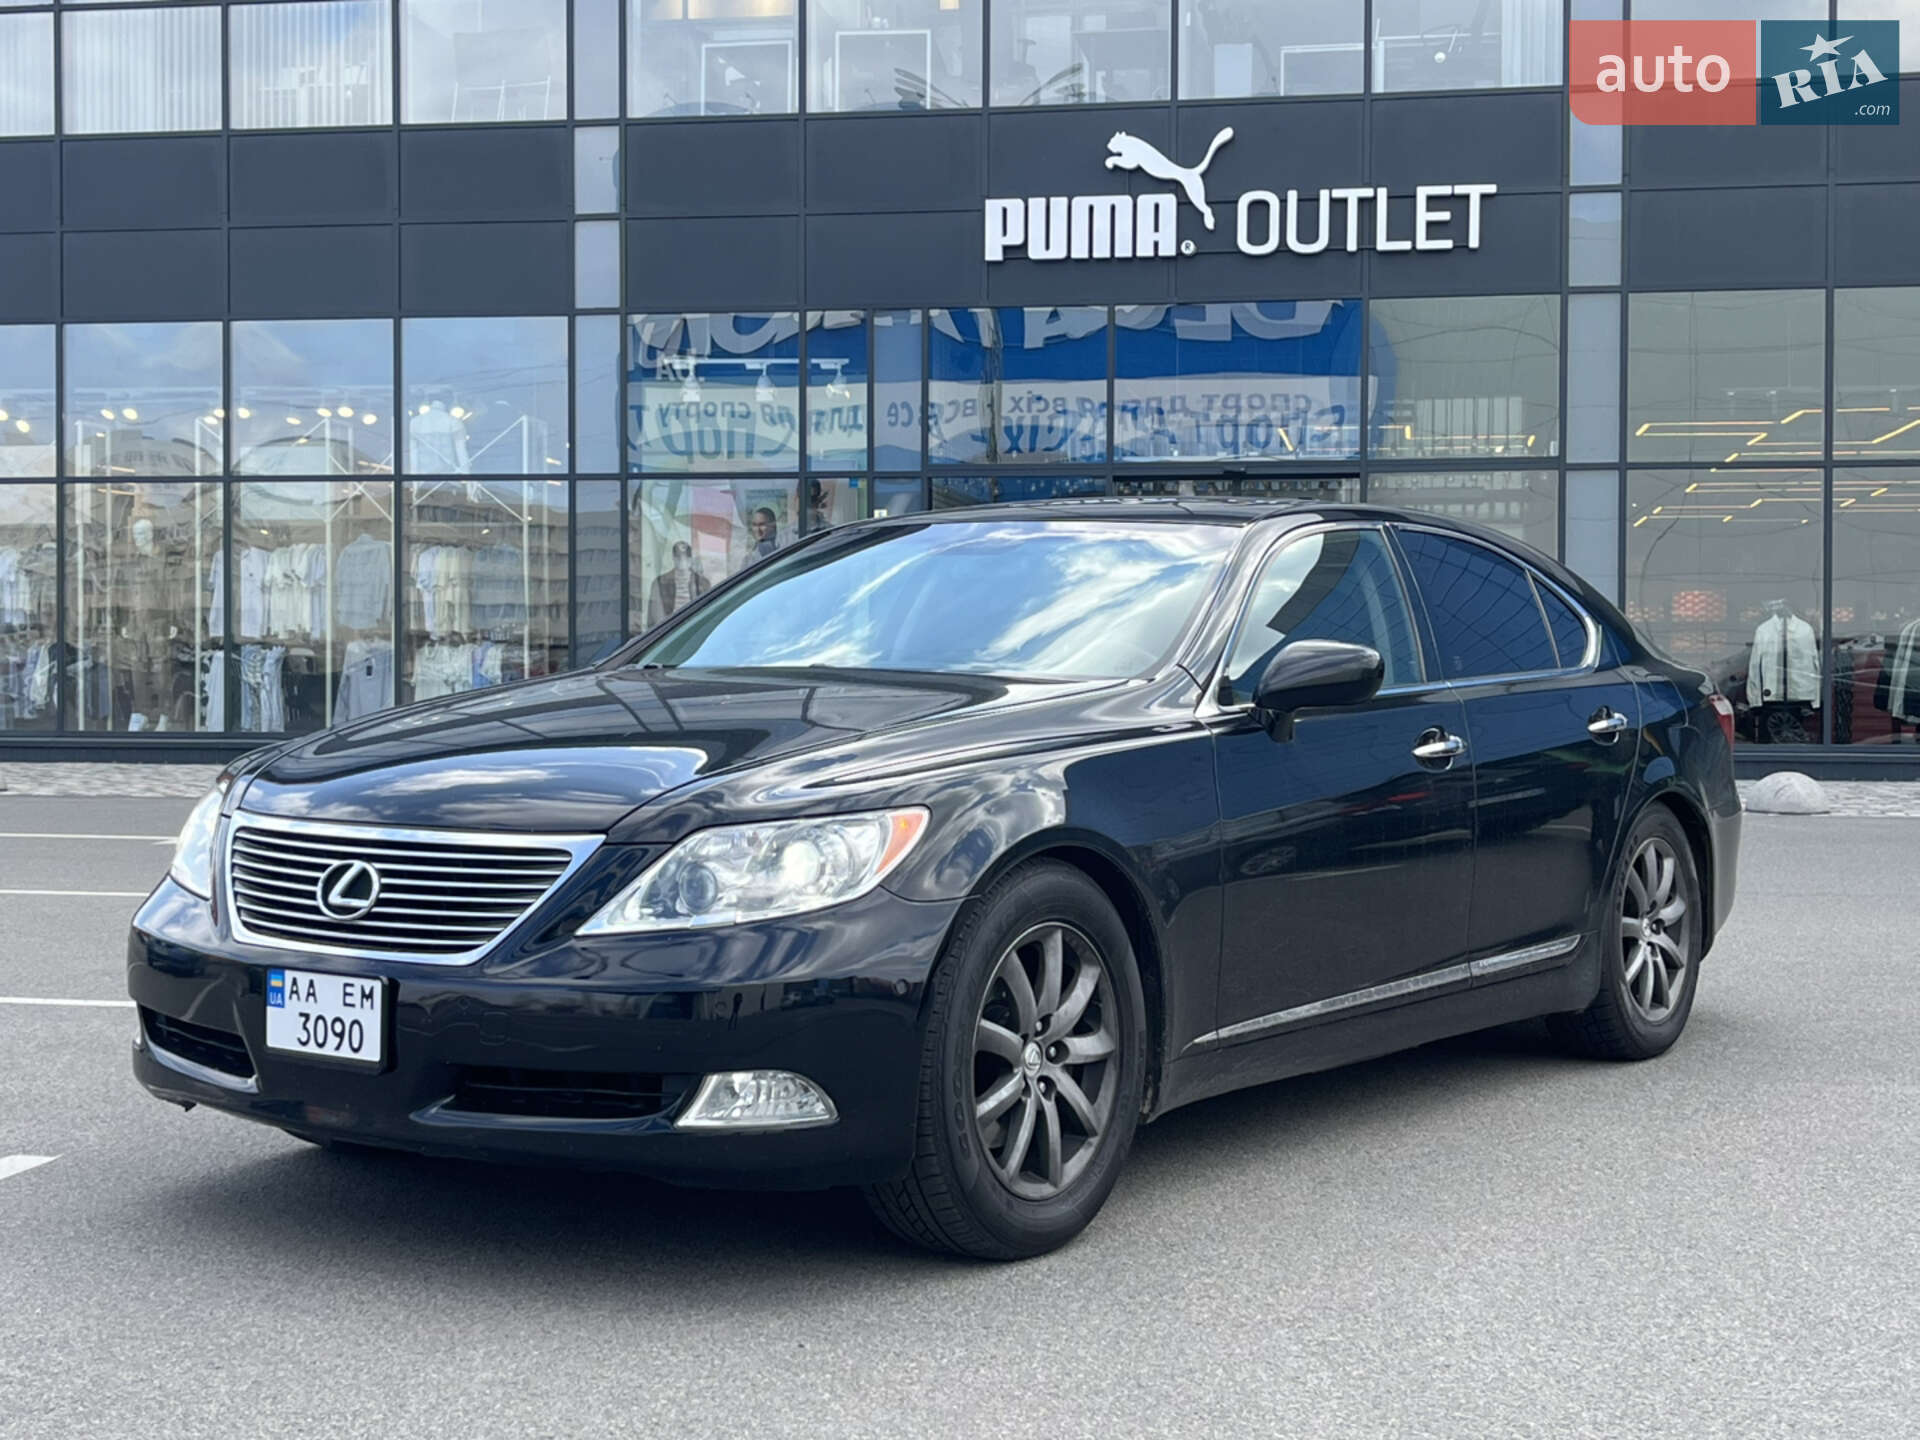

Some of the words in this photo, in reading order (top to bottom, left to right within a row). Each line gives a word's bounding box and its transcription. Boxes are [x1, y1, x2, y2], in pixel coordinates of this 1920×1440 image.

[1236, 183, 1498, 256] OUTLET
[269, 992, 284, 1006] UA
[297, 1012, 364, 1054] 3090
